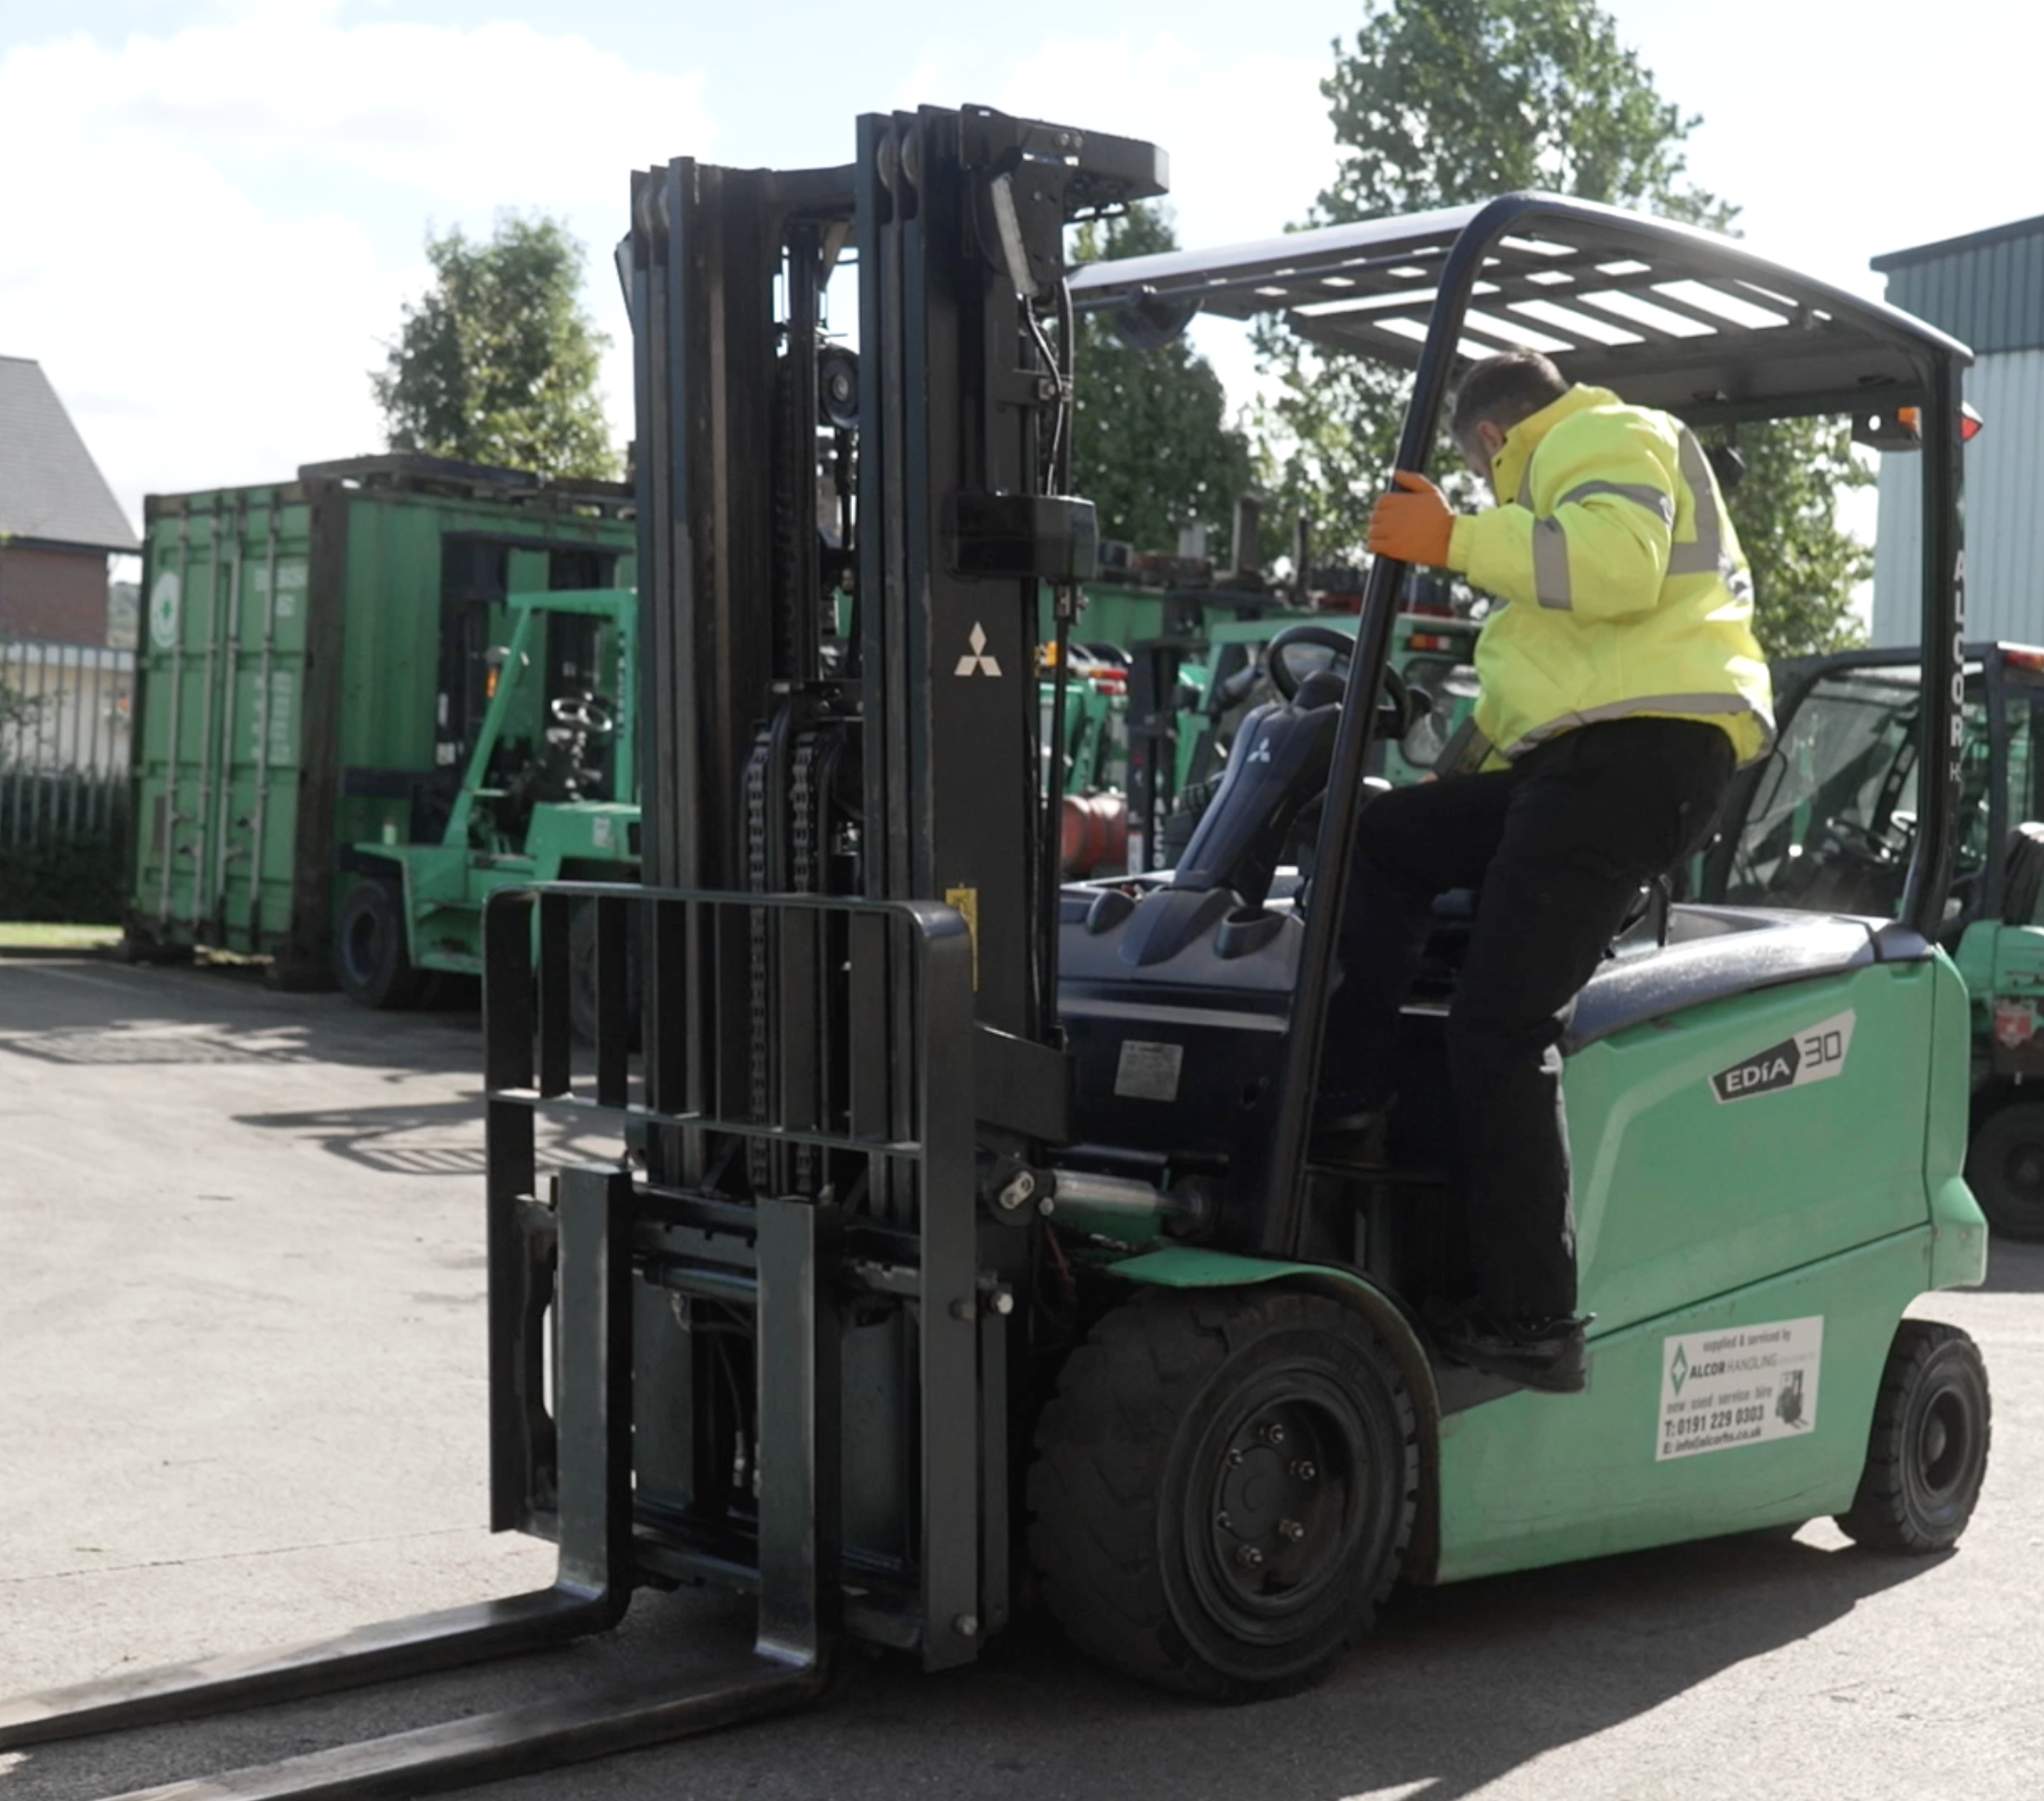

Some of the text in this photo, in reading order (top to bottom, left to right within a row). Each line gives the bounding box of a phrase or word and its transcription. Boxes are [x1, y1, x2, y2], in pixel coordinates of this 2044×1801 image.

[1951, 549, 1965, 747] ALCOR
[1804, 1030, 1842, 1068] 30
[1702, 1329, 1791, 1353] supplied & serviced by
[1667, 1386, 1772, 1414] new used service hire
[1677, 1415, 1707, 1435] 0191
[1711, 1410, 1732, 1429] 229
[1736, 1404, 1765, 1424] 0303
